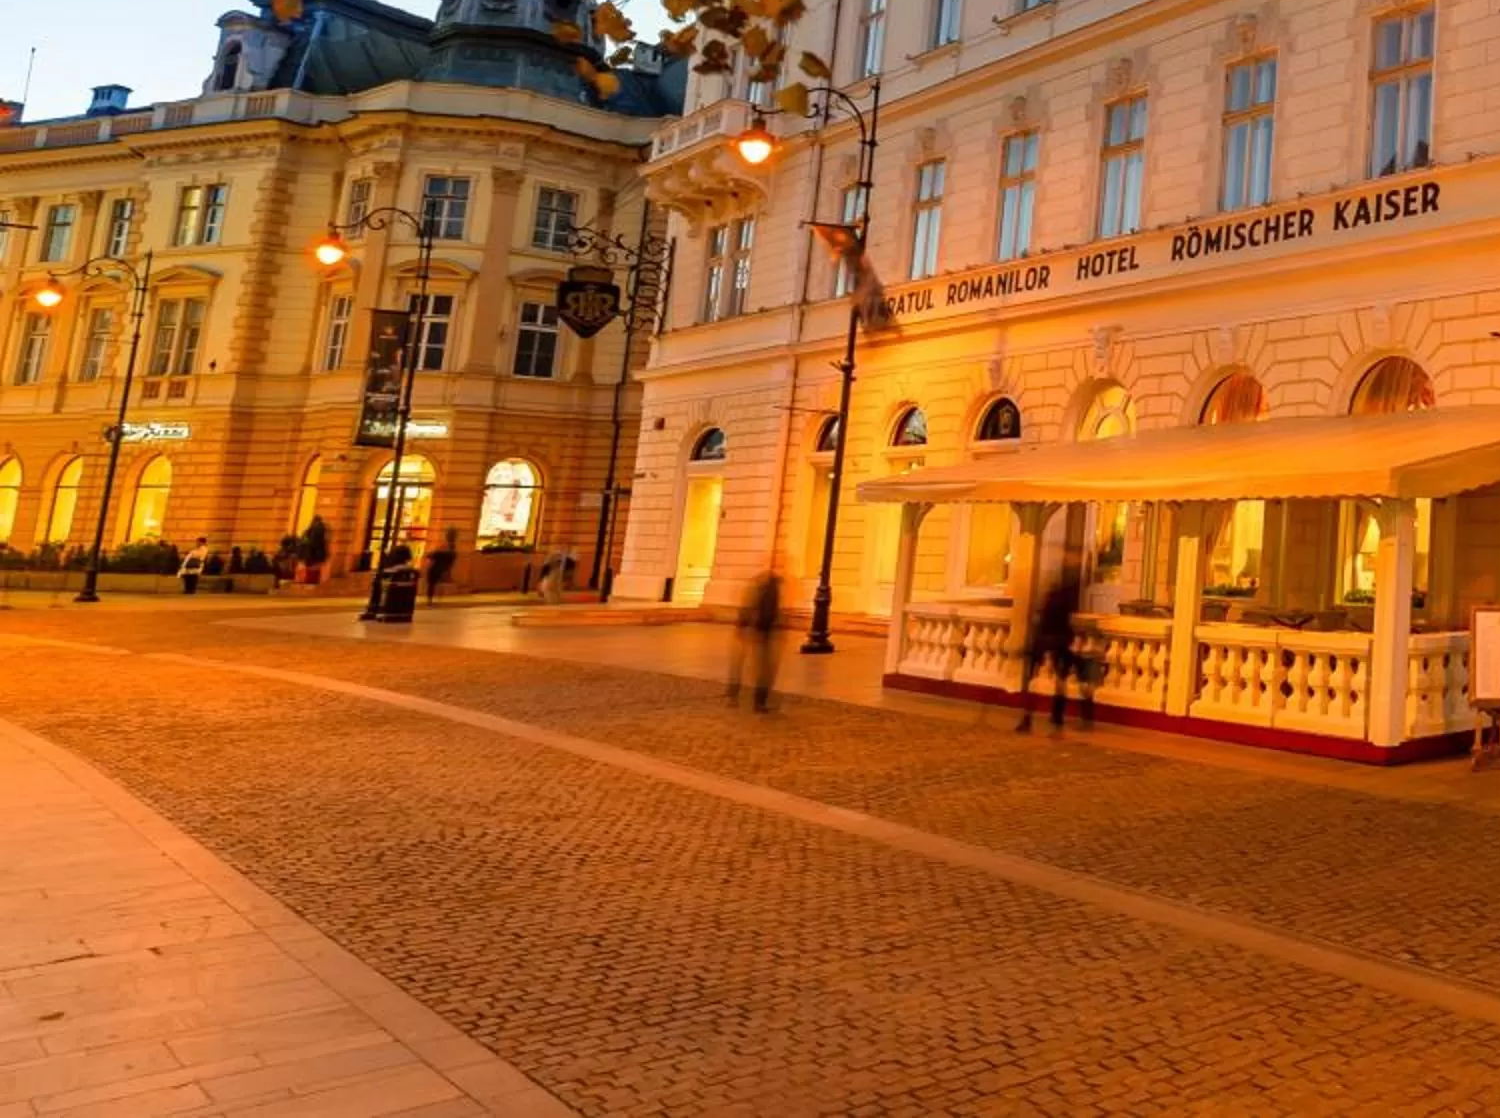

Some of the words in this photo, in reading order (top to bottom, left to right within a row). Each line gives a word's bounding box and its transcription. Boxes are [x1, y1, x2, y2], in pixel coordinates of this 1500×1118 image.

[946, 266, 1050, 307] ROMANILOR
[1076, 246, 1140, 280] HOTEL
[1171, 208, 1315, 261] RÖMISCHER
[1333, 182, 1441, 231] KAISER
